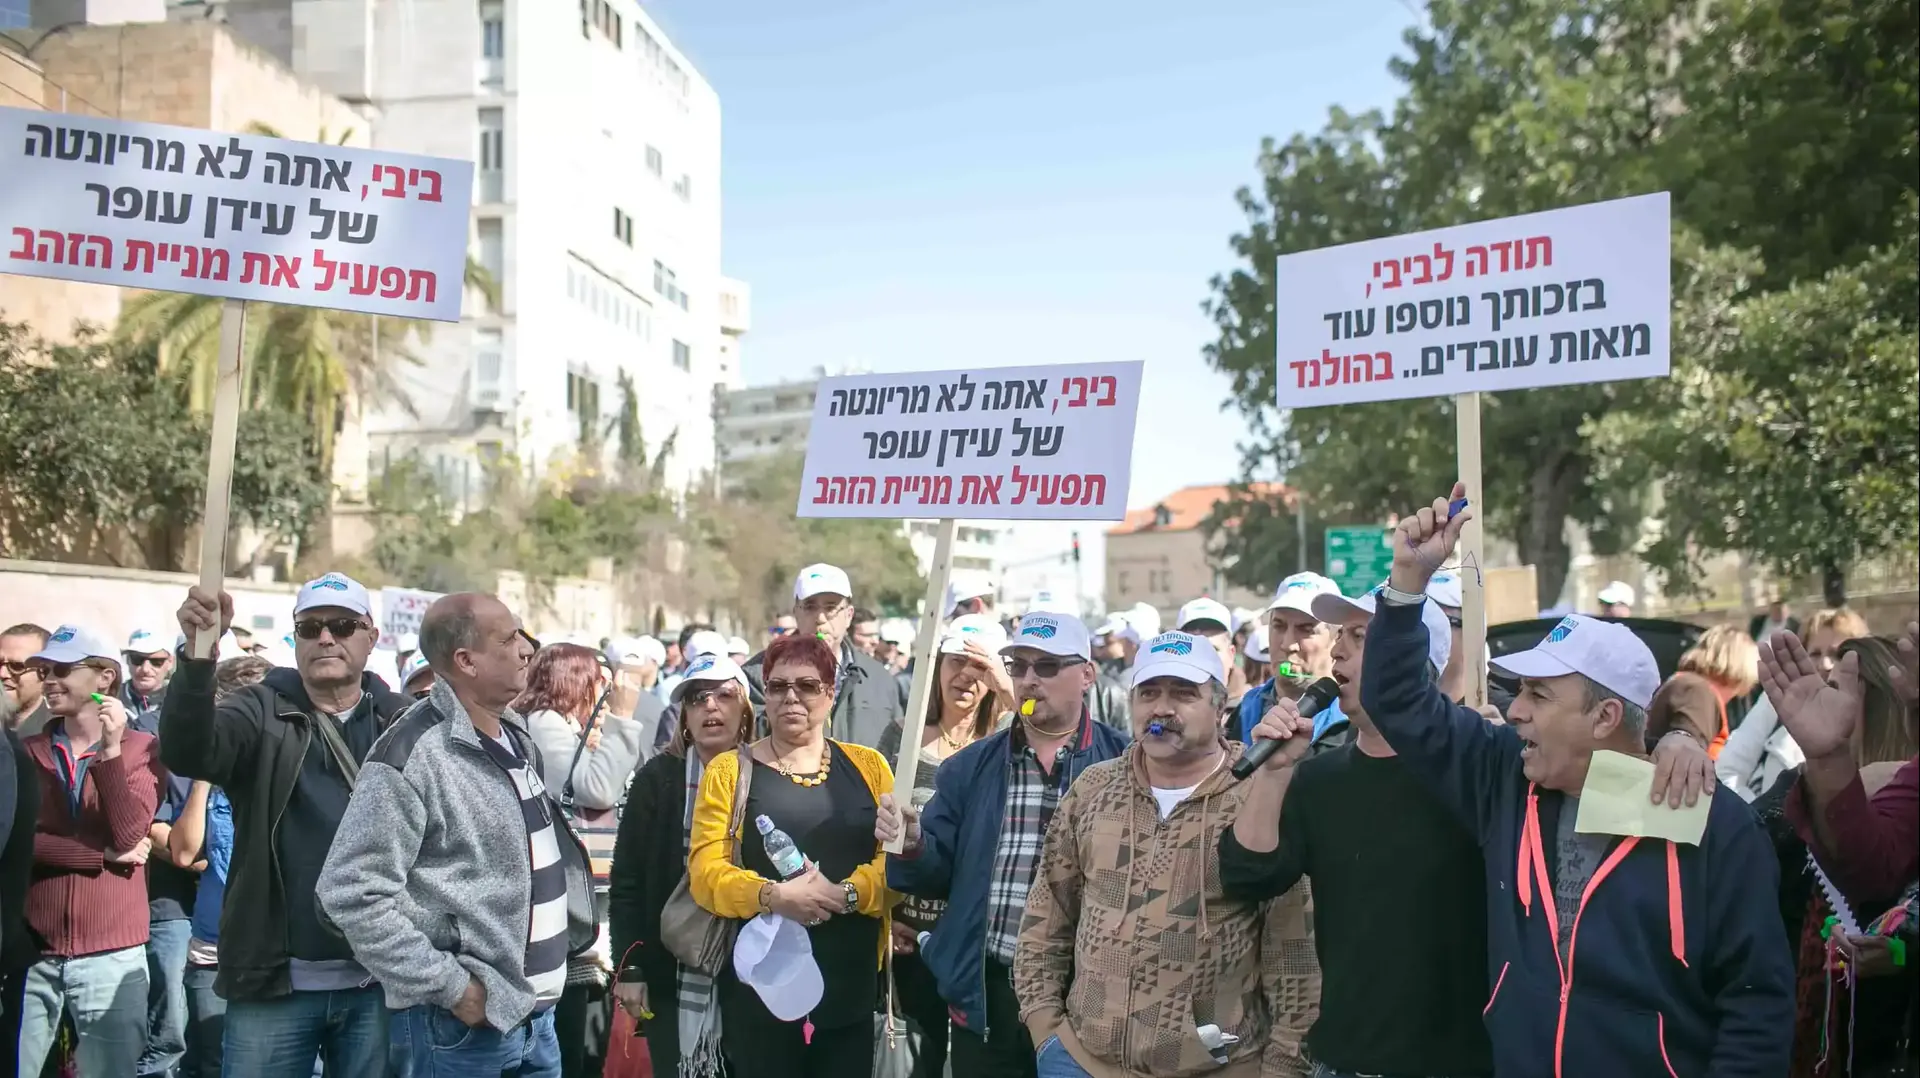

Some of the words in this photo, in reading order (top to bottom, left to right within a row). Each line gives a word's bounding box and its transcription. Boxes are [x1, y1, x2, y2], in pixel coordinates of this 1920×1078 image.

[24, 124, 185, 173] מריונטה
[196, 138, 253, 179] לא
[264, 152, 352, 192] אתה
[360, 165, 443, 202] ביבי,
[85, 183, 192, 224] עופר
[204, 197, 295, 239] עידן
[309, 198, 378, 244] של
[9, 226, 114, 269] הזהב
[123, 240, 230, 281] מניית
[1465, 235, 1552, 277] תודה
[239, 251, 301, 289] את
[313, 249, 437, 303] תפעיל
[1365, 242, 1455, 298] לביבי,
[1324, 308, 1375, 340] עוד
[1386, 296, 1470, 334] נוספו
[1481, 278, 1606, 331] בזכותך
[1404, 335, 1538, 378] עובדים..
[1549, 323, 1650, 364] מאות
[1289, 349, 1394, 388] בהולנד
[830, 385, 930, 416] מריונטה
[935, 374, 976, 412] לא
[981, 379, 1048, 410] אתה
[1052, 376, 1117, 415] ביבי,
[863, 430, 931, 459] עופר
[936, 428, 1002, 467] עידן
[1012, 418, 1064, 456] של
[813, 476, 876, 504] הזהב
[881, 475, 952, 504] מניית
[957, 475, 1003, 504] את
[1011, 466, 1106, 505] תפעיל
